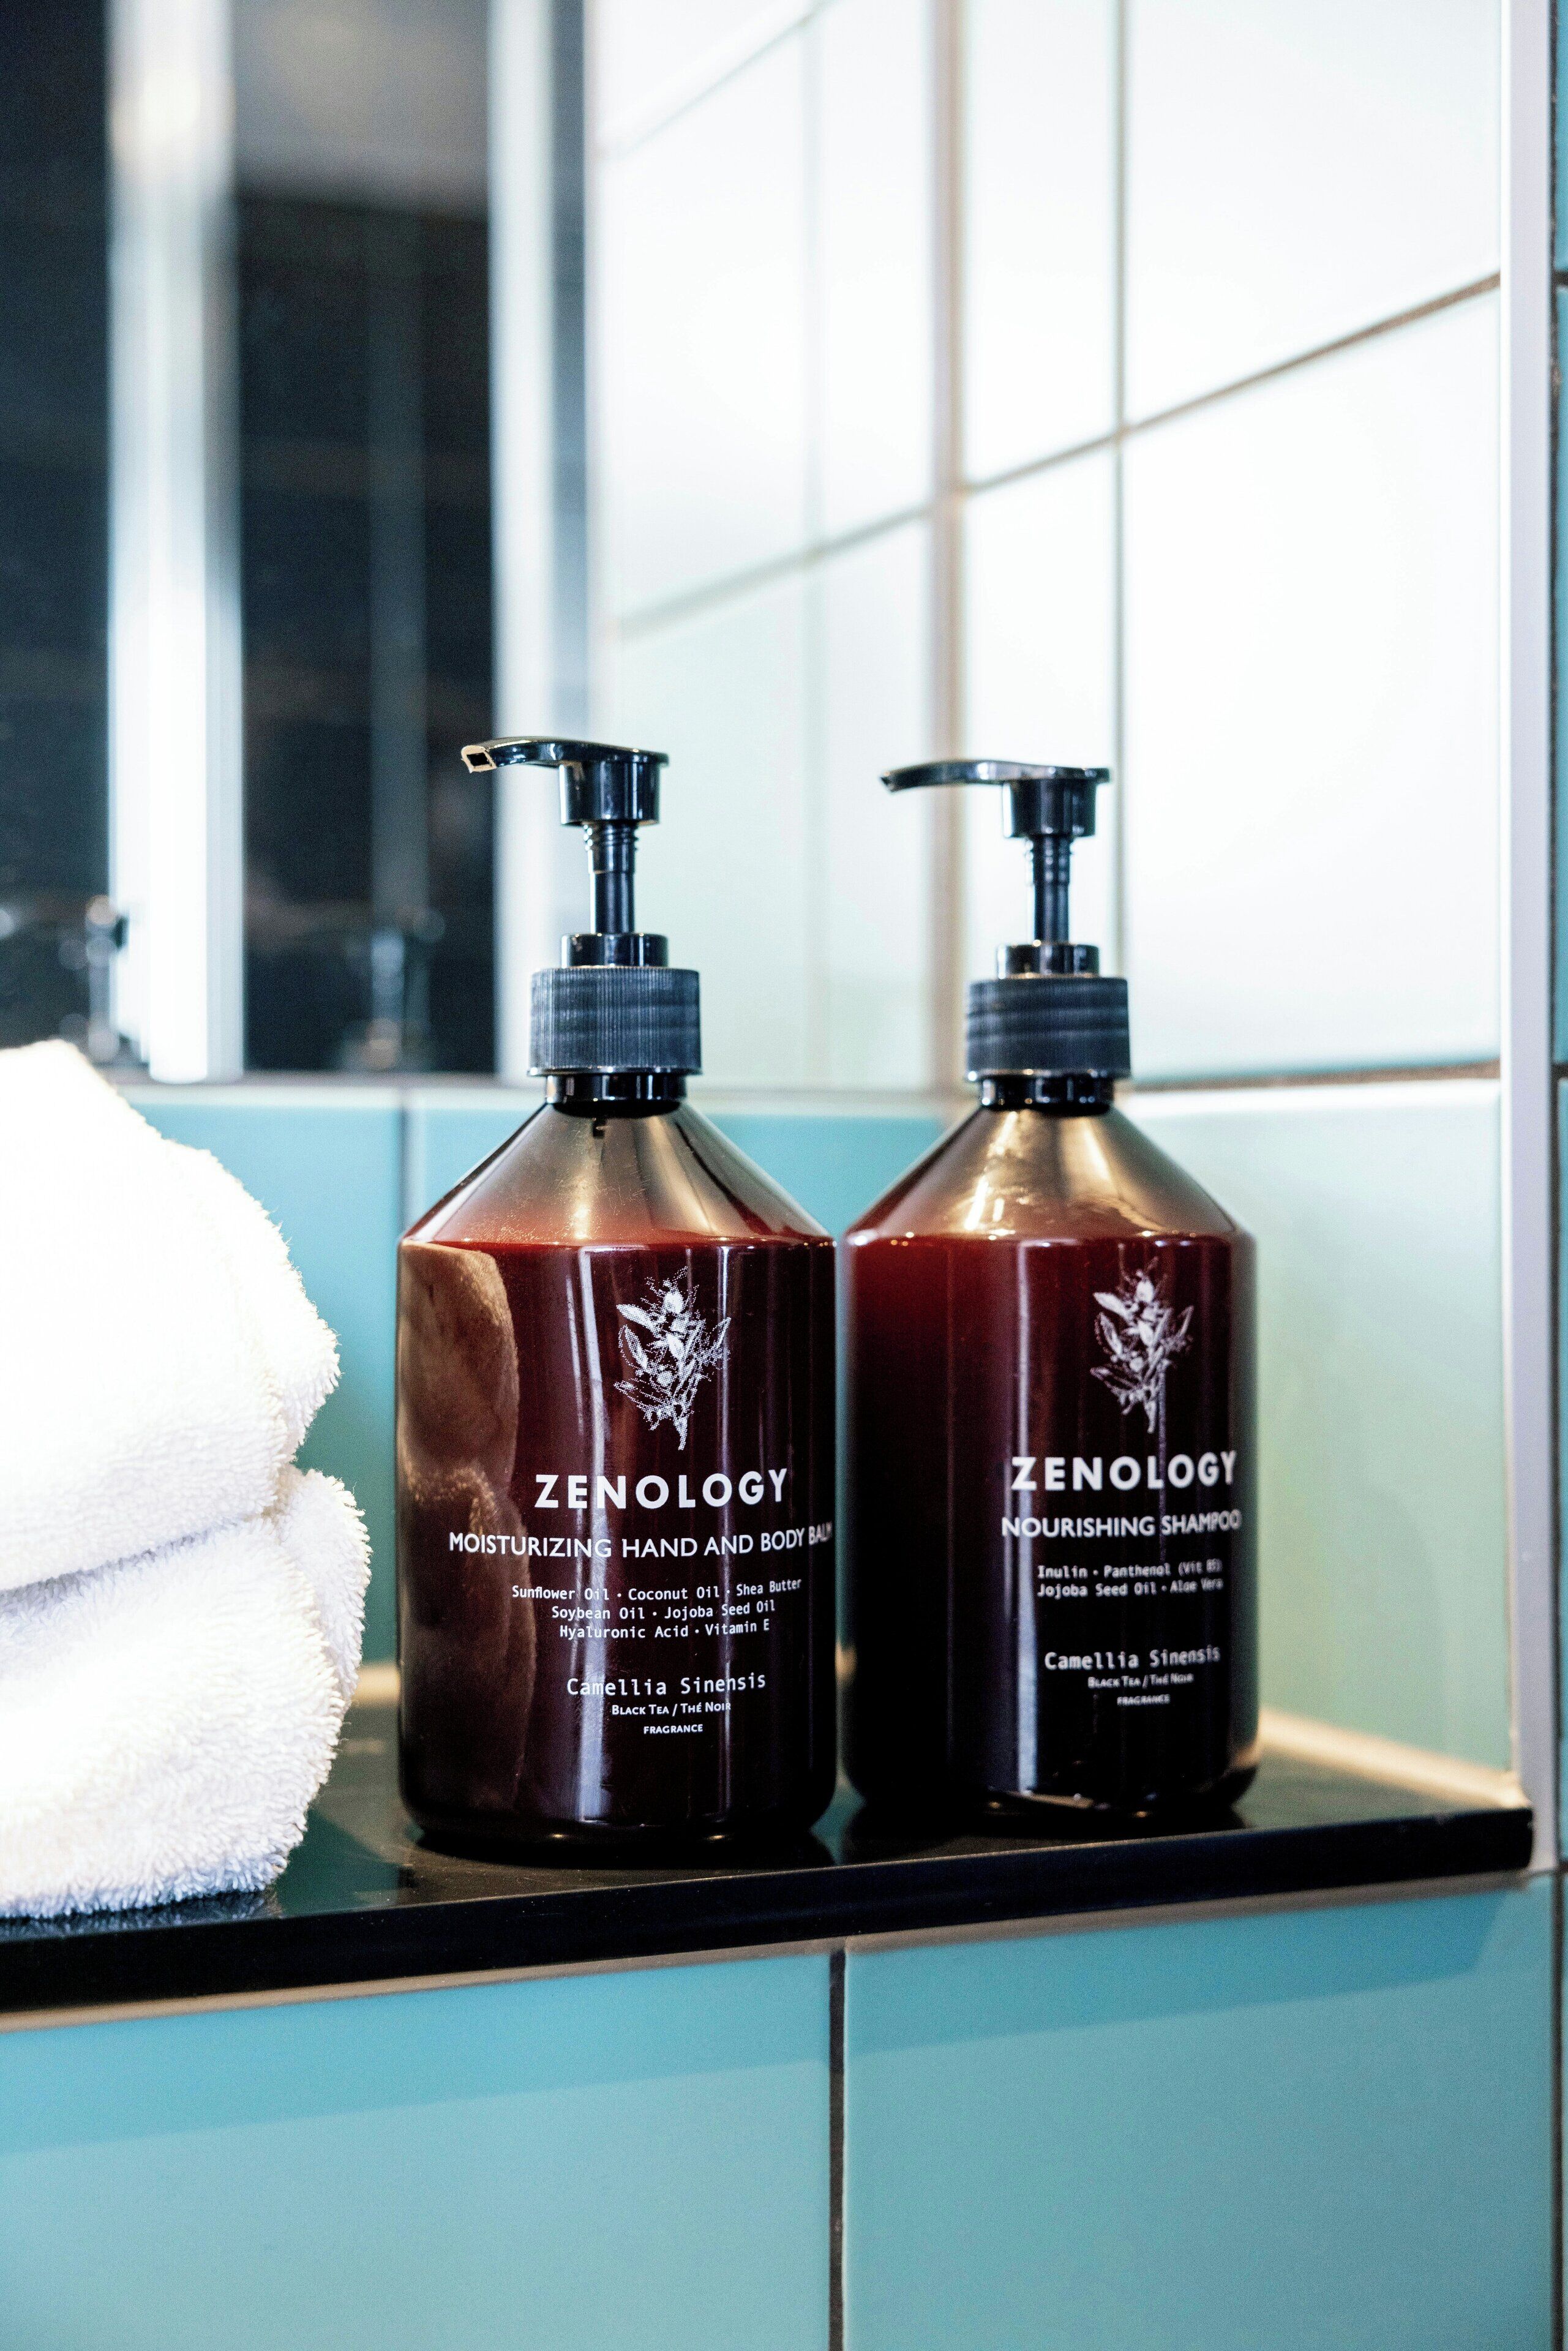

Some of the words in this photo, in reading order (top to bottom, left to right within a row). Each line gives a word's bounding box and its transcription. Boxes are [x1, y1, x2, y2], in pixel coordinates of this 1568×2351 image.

[1011, 1450, 1237, 1490] ZENOLOGY
[535, 1468, 787, 1509] ZENOLOGY
[1002, 1516, 1155, 1537] NOURISHING
[1161, 1509, 1242, 1535] SHAMPOO
[449, 1532, 612, 1558] MOISTURIZING
[622, 1537, 698, 1558] HAND
[703, 1534, 754, 1556] AND
[760, 1528, 805, 1552] BODY
[1037, 1565, 1087, 1579] Inulin
[1103, 1562, 1171, 1578] Panthenol
[512, 1585, 574, 1600] Sunflower
[584, 1588, 609, 1600] Oil
[628, 1587, 688, 1600] Coconut
[697, 1586, 719, 1599] Oil
[736, 1583, 763, 1597] Shea
[769, 1578, 801, 1594] Butter
[1037, 1583, 1087, 1599] Jojoba
[1095, 1583, 1127, 1596] Seed
[1134, 1581, 1156, 1595] Oil
[552, 1606, 610, 1621] Soybean
[620, 1607, 645, 1619] Oil
[664, 1605, 713, 1621] Jojoba
[721, 1602, 750, 1616] Seed
[756, 1599, 775, 1613] Oil
[560, 1625, 645, 1640] Hyaluronic
[655, 1625, 688, 1638] Acid
[705, 1621, 757, 1636] Vitamin
[763, 1619, 770, 1632] E
[1045, 1651, 1139, 1670] Camellia
[1149, 1644, 1221, 1668] Sinensis
[567, 1678, 666, 1697] Camellia
[681, 1672, 765, 1694] Sinensis
[643, 1724, 703, 1734] FRAGRANCE
